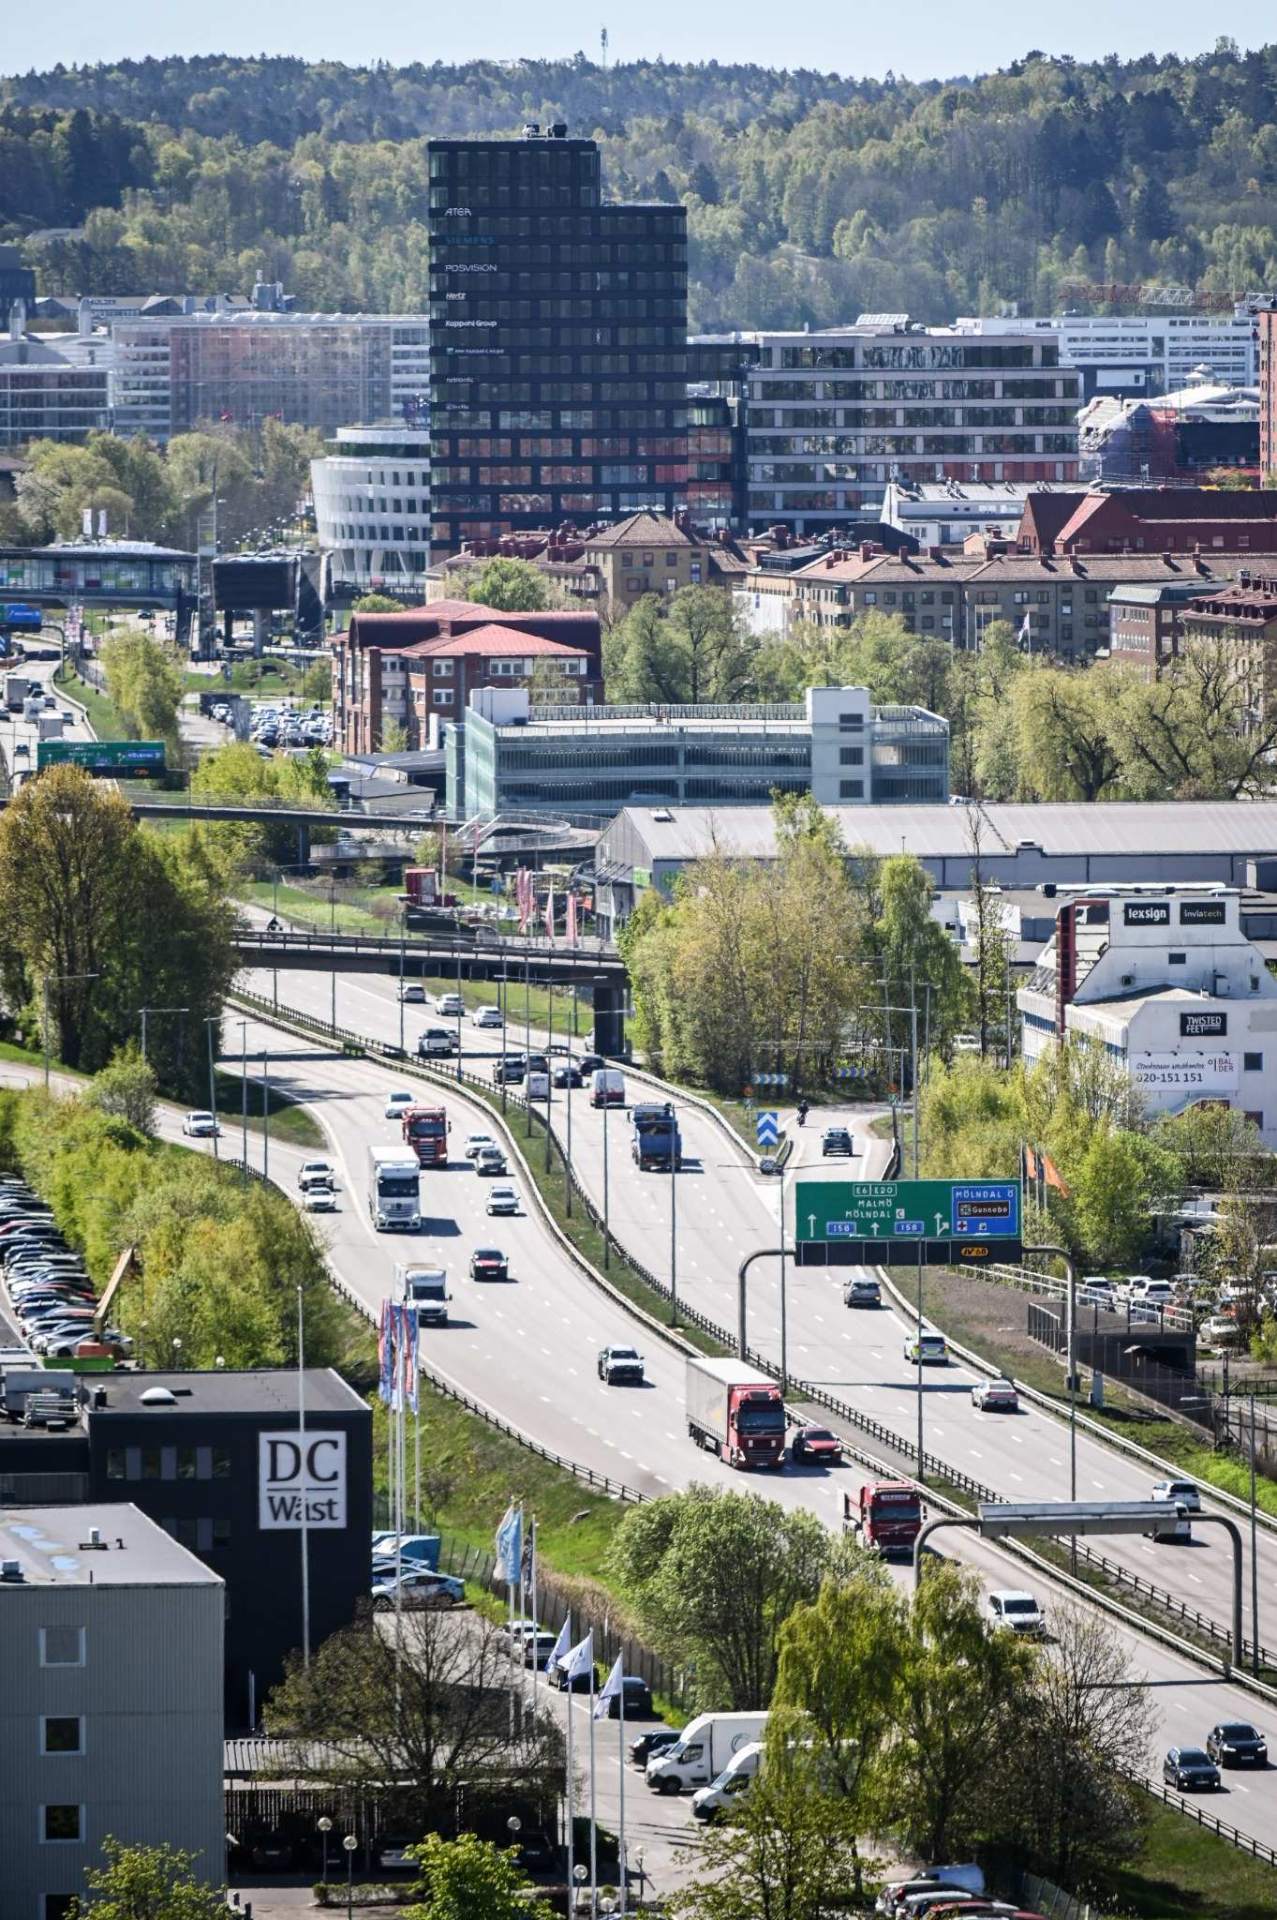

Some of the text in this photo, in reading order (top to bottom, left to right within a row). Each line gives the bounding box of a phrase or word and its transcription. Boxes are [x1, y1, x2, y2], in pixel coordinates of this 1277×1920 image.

[444, 207, 472, 217] ATEA
[445, 264, 498, 272] POSVISION
[475, 320, 498, 328] Group
[1187, 1016, 1222, 1026] TWISTED
[1186, 1025, 1205, 1034] FEET
[1136, 1072, 1203, 1083] 020-151 151
[856, 1186, 894, 1195] E6 E20
[955, 1188, 1014, 1199] MÖLNDAL Ö
[858, 1199, 892, 1208] MALMÖ
[845, 1209, 891, 1219] MÖLNDAL
[833, 1224, 850, 1232] 158
[901, 1223, 918, 1231] 158
[266, 1439, 339, 1482] DC
[267, 1495, 339, 1522] Wäst
